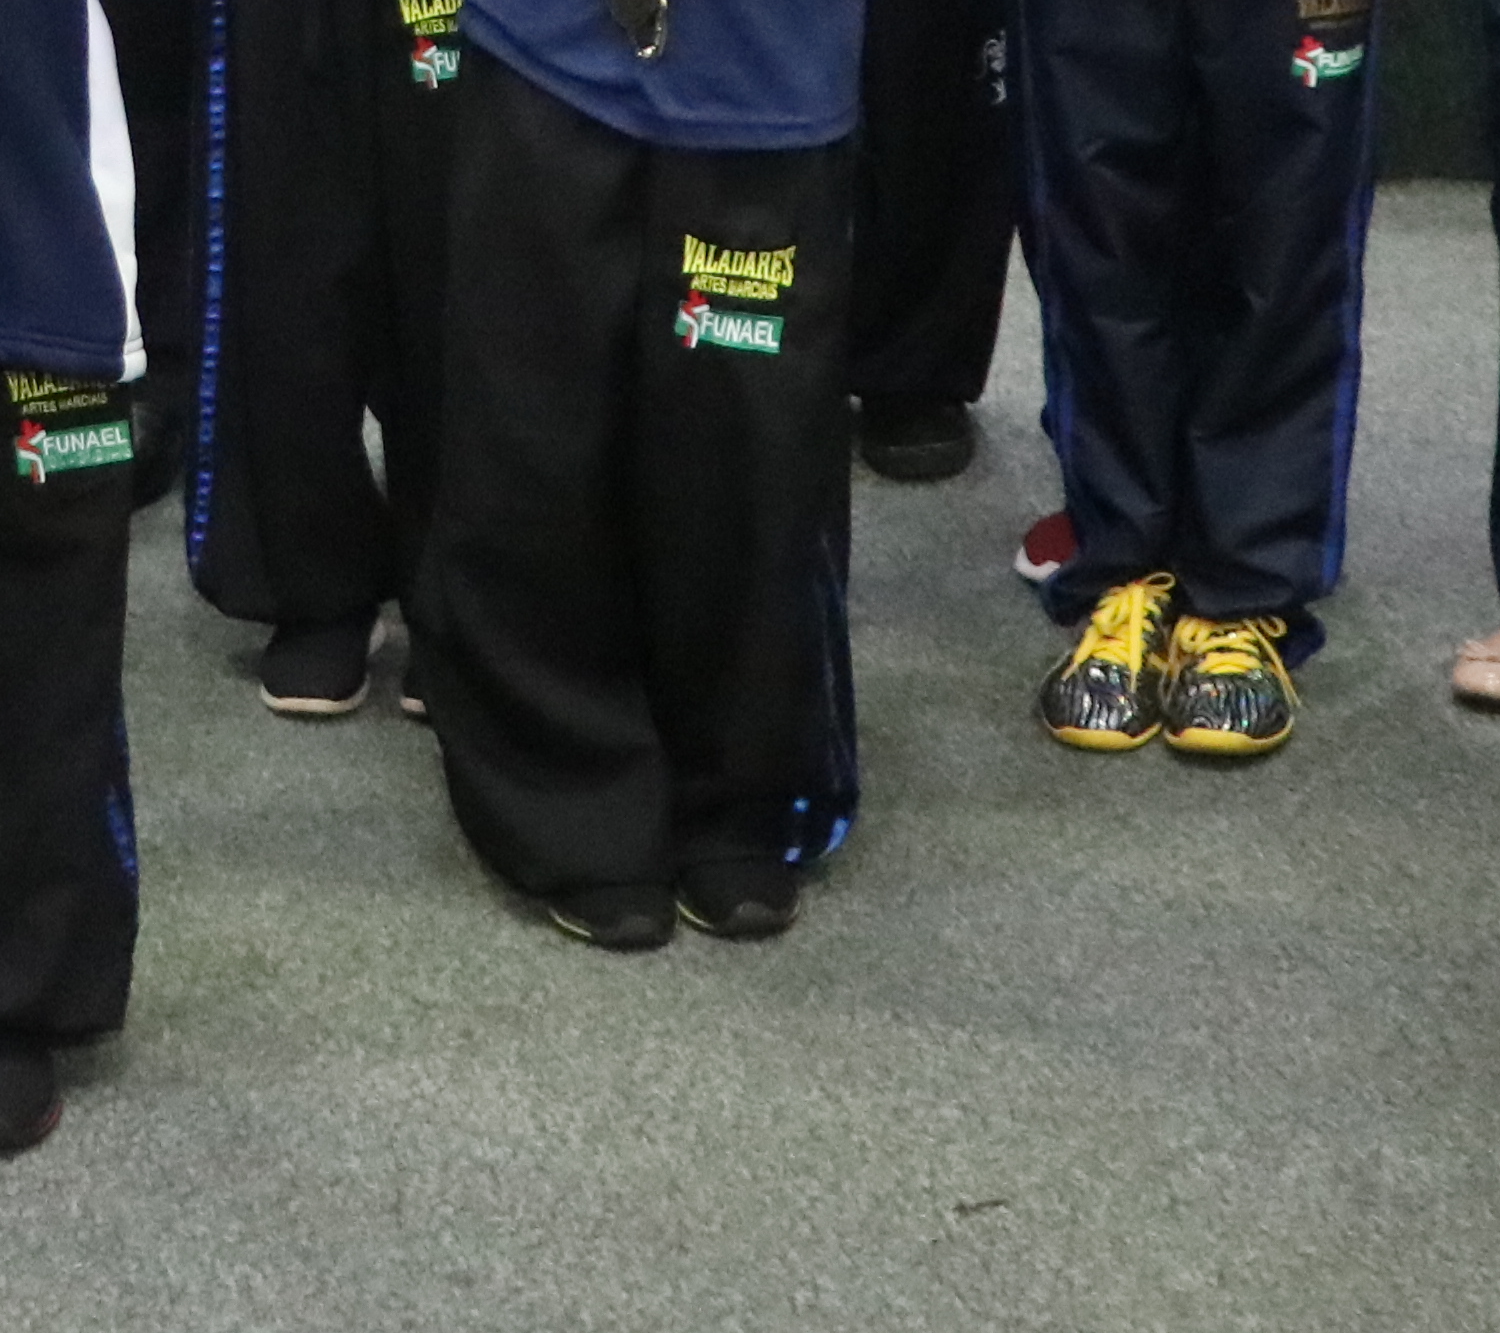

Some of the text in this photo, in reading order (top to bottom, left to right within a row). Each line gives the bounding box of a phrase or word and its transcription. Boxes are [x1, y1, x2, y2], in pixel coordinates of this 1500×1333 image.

[682, 233, 797, 288] VALADARES
[690, 273, 728, 293] ARTES
[700, 311, 780, 348] FUNAEL
[42, 426, 129, 456] FUNAEL
